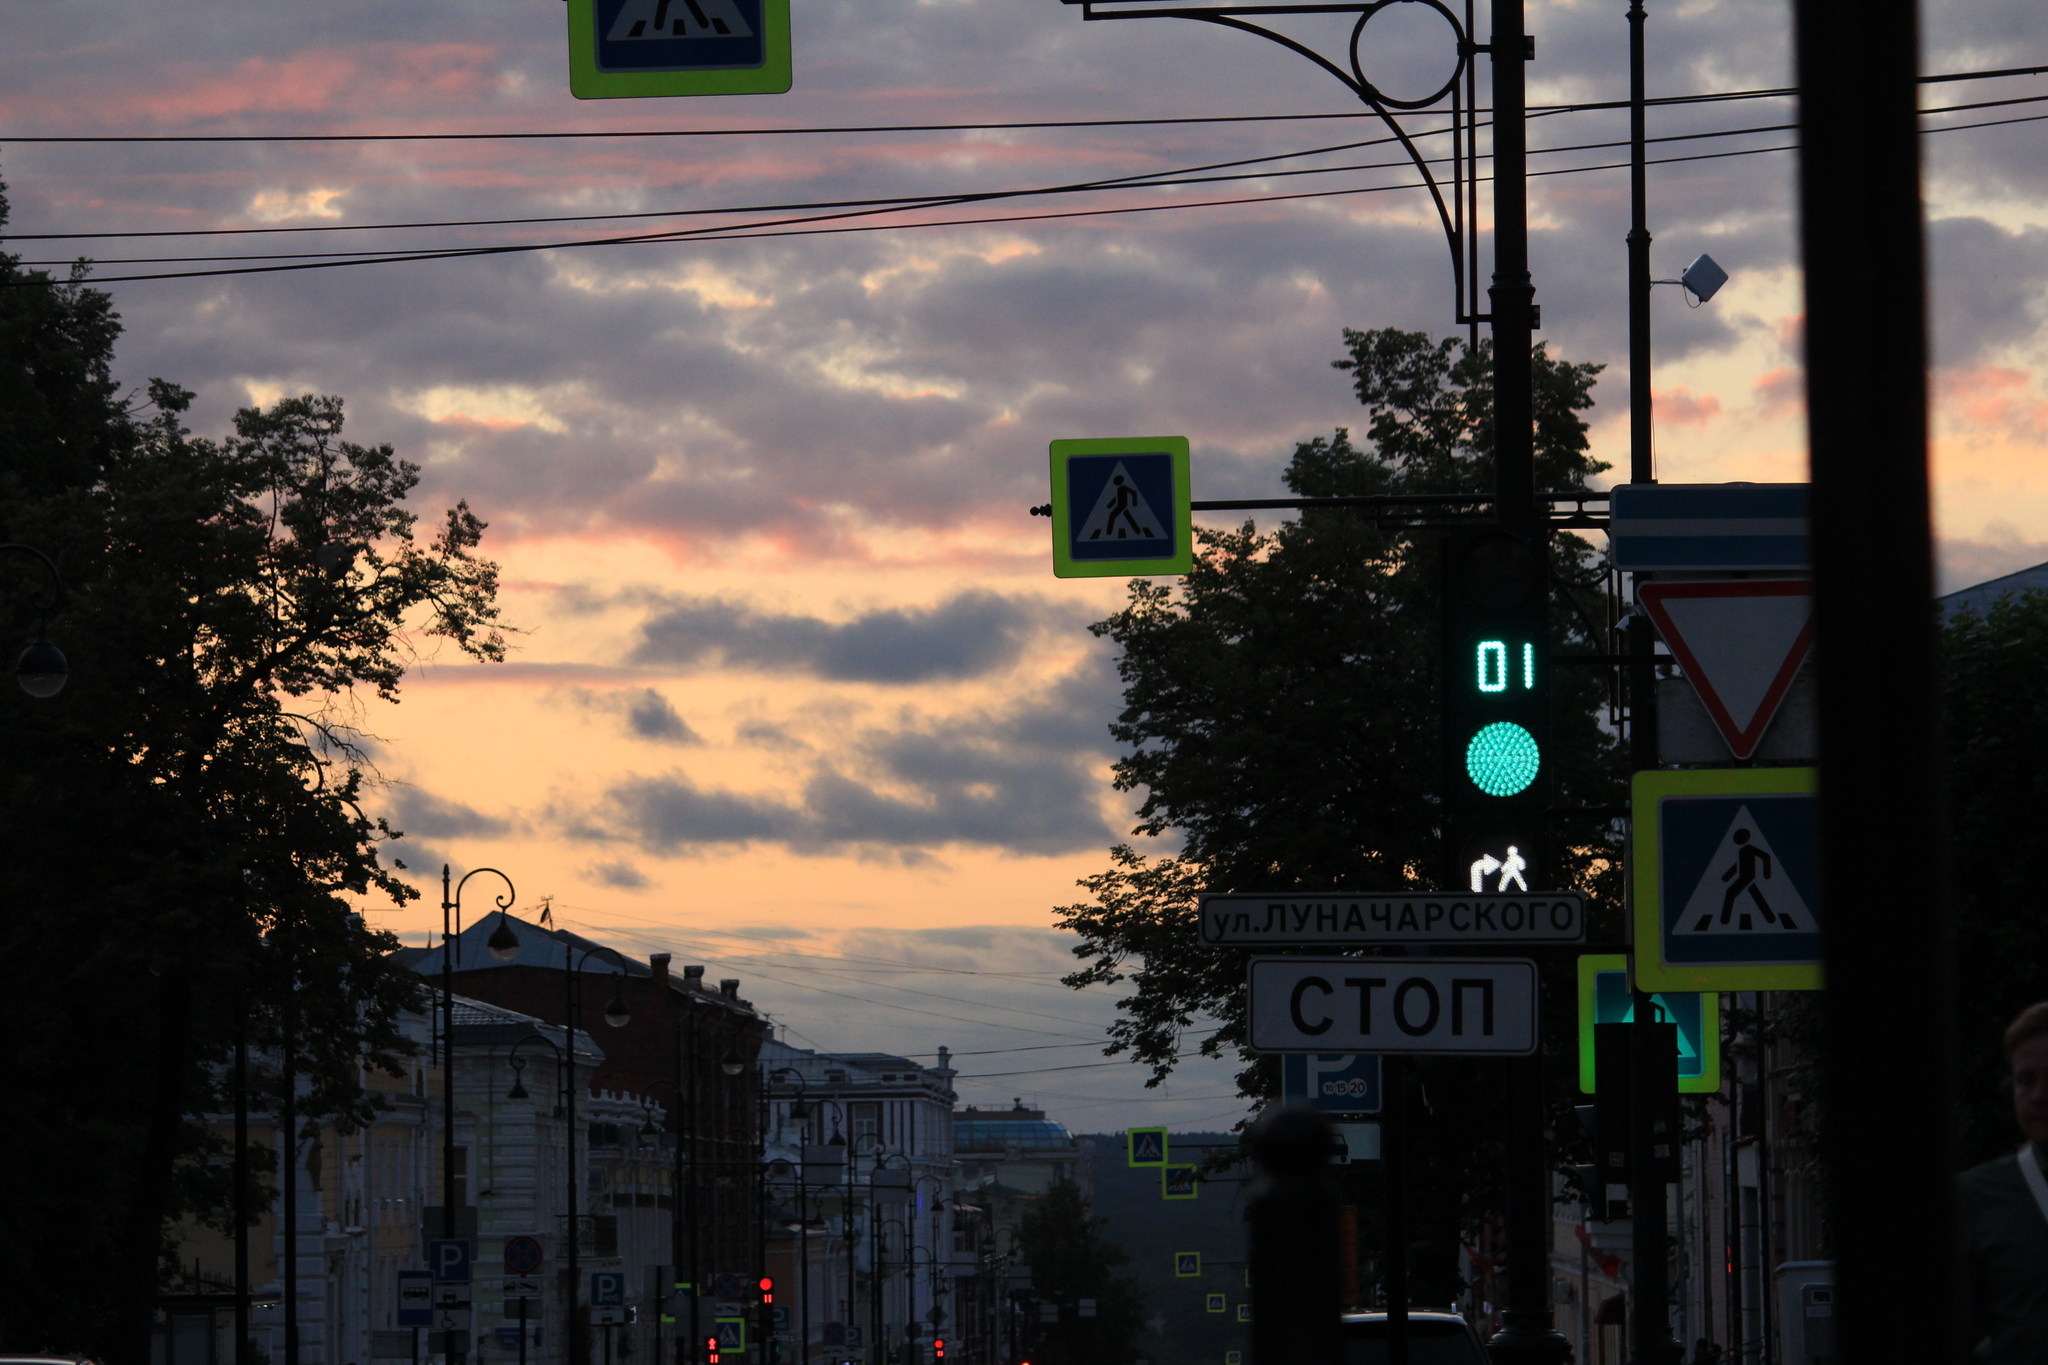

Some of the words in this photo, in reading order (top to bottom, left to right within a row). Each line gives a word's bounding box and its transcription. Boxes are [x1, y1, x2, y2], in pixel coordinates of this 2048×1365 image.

[1477, 640, 1534, 692] 01
[1290, 977, 1494, 1037] СТОП
[1326, 1084, 1333, 1092] 10
[1337, 1083, 1347, 1092] 15
[1350, 1082, 1365, 1093] 20
[440, 1245, 462, 1277] P
[598, 1275, 617, 1303] P
